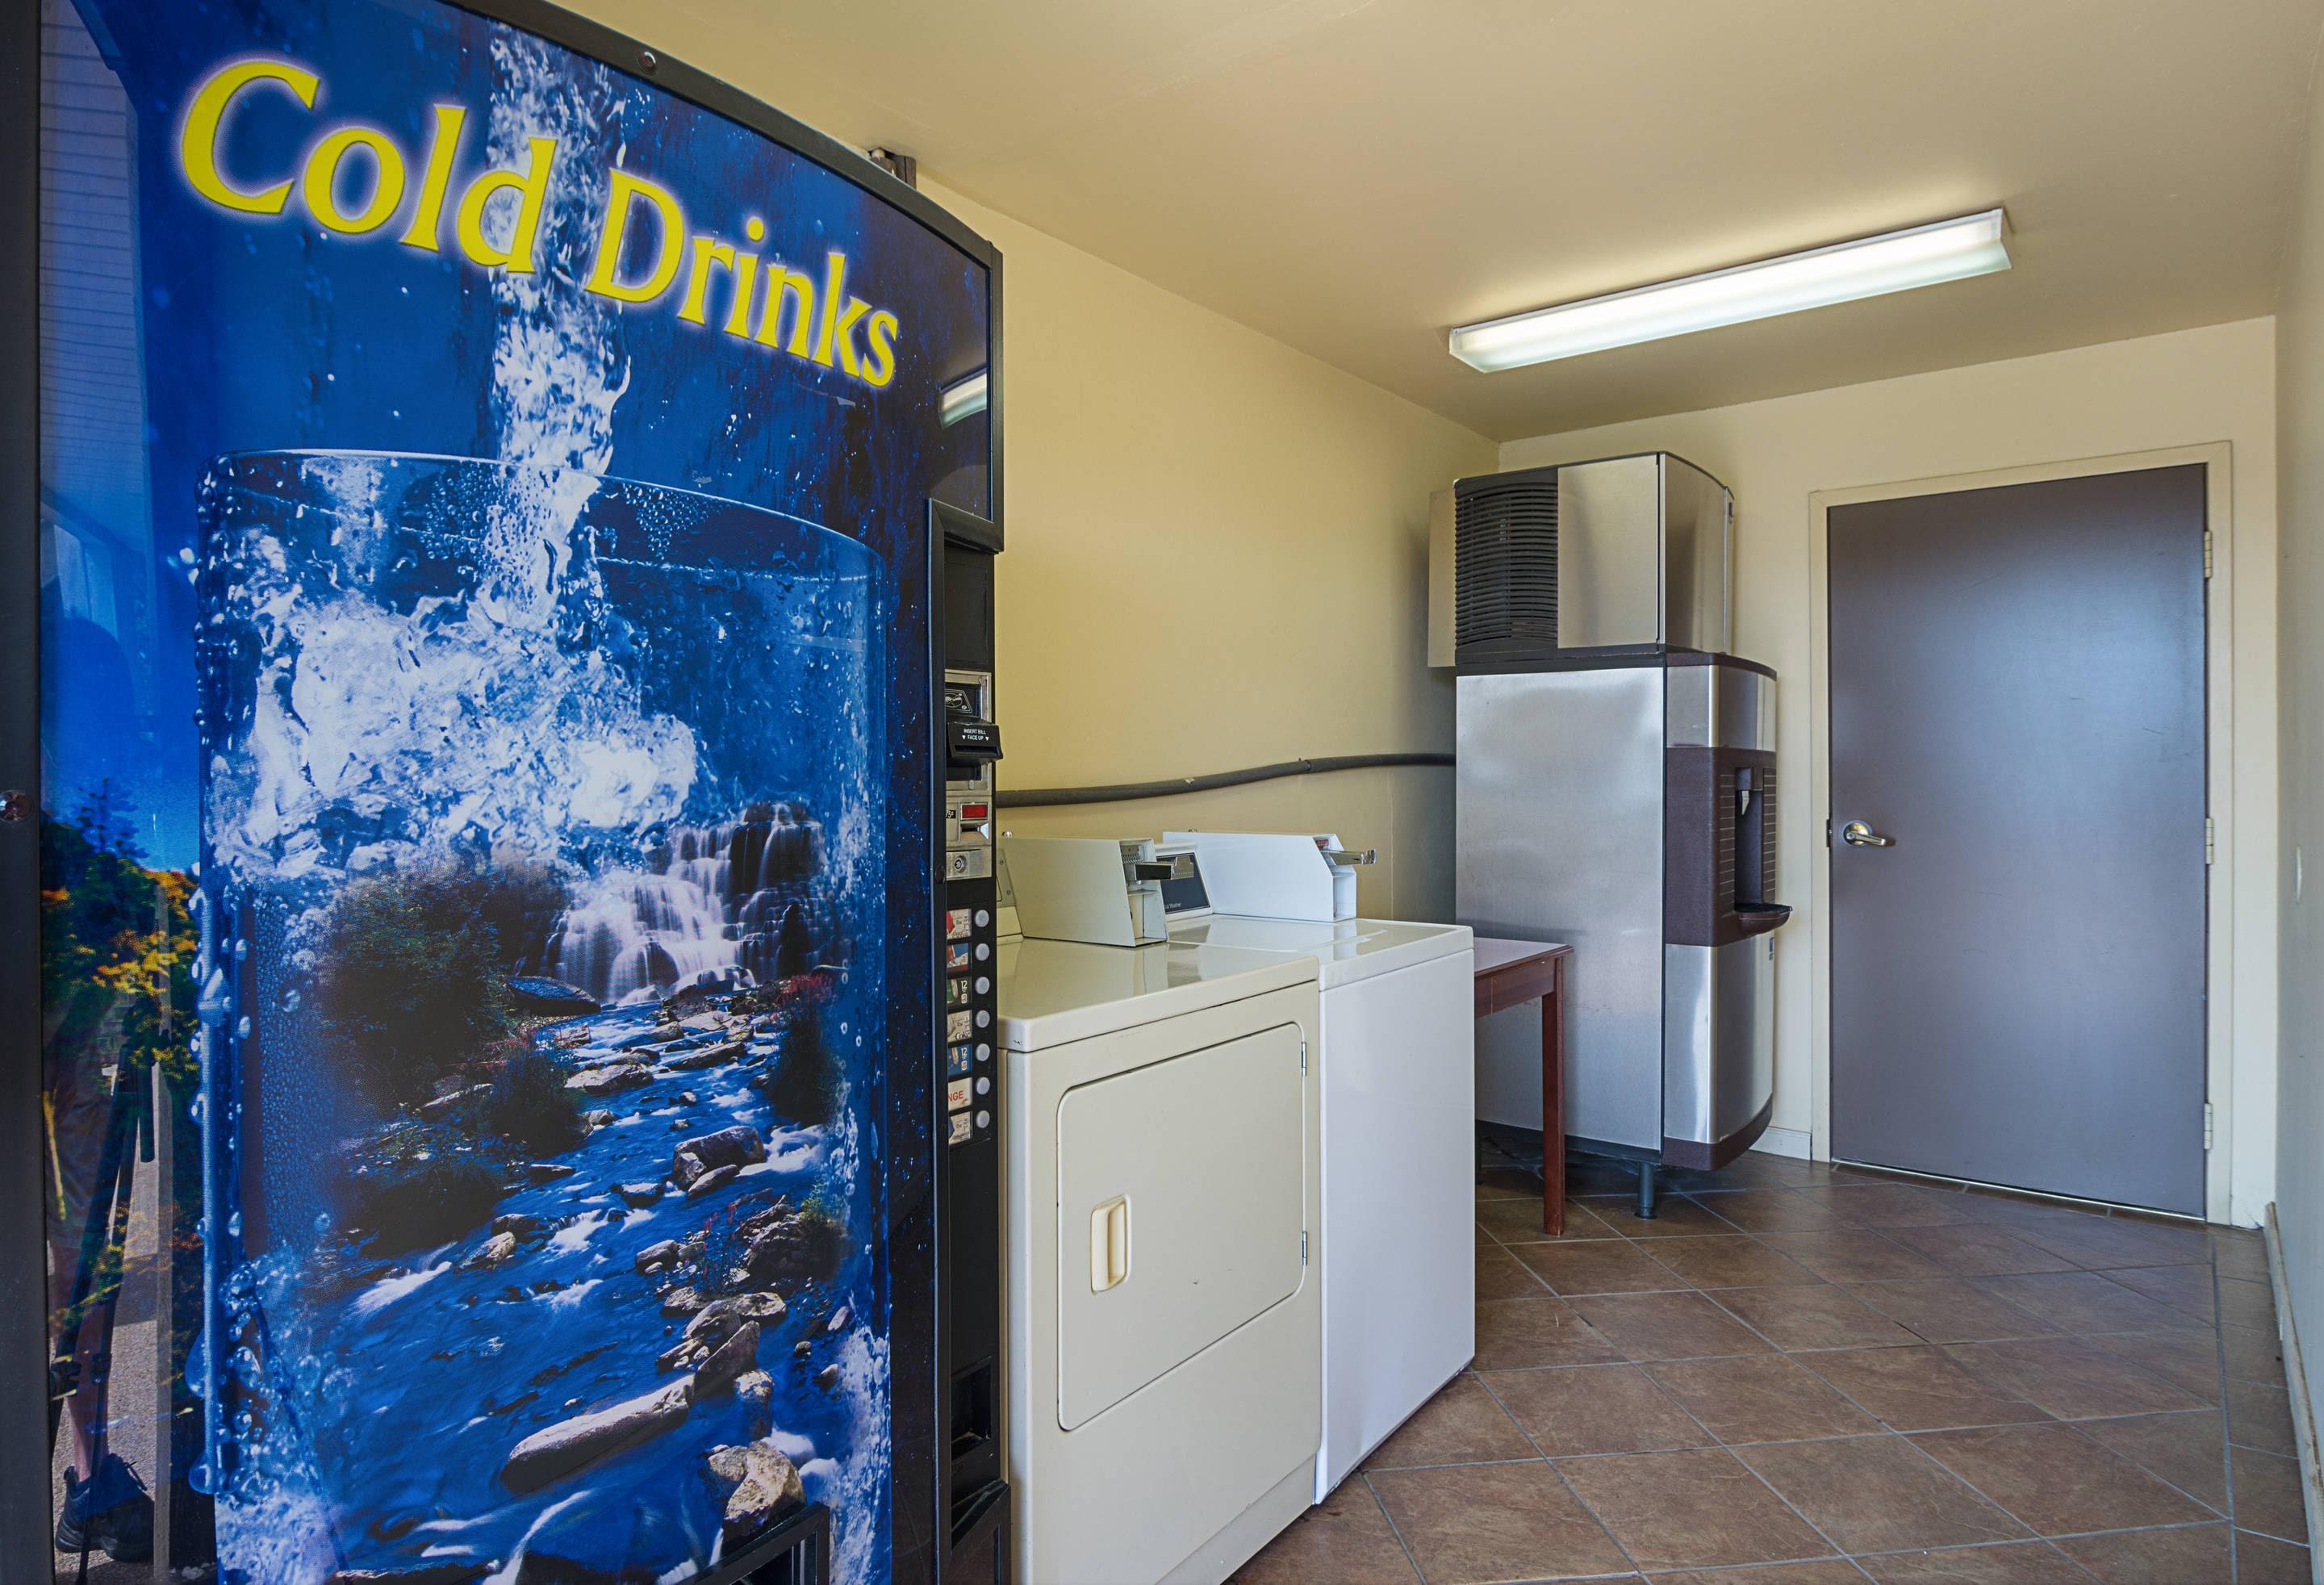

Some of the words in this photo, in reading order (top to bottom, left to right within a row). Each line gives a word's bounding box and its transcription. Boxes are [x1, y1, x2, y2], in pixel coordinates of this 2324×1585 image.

[182, 60, 558, 273] Cold
[584, 167, 899, 387] Drinks
[961, 981, 968, 989] 12
[961, 1047, 968, 1056] 12
